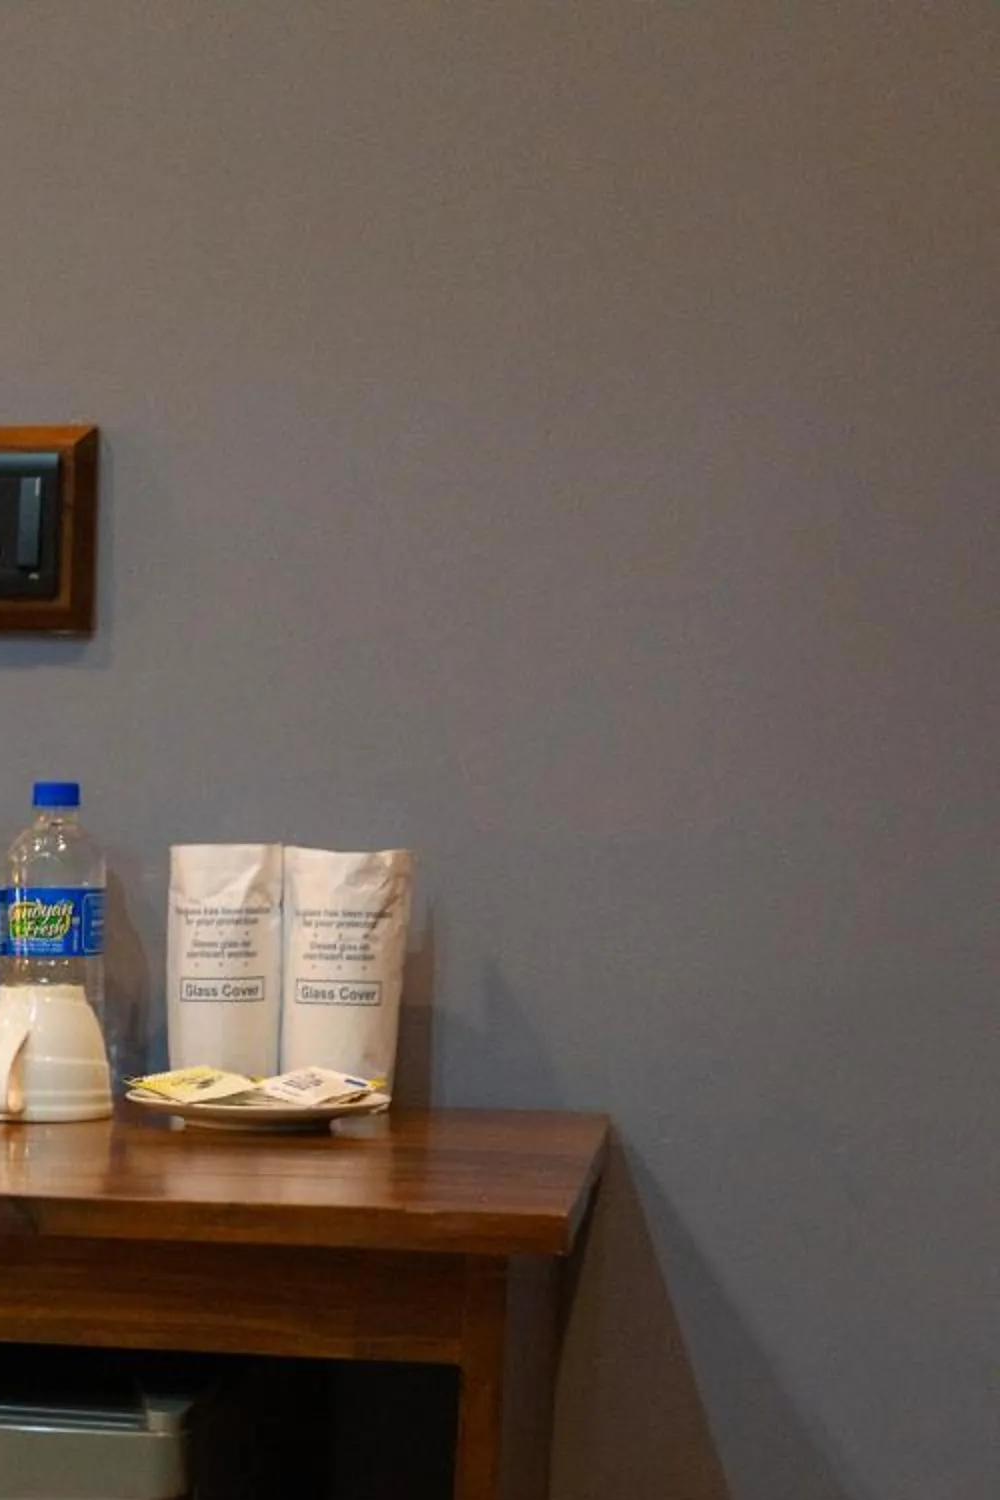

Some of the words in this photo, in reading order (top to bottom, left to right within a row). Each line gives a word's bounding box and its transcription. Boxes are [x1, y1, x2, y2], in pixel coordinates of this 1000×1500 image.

[26, 918, 65, 937] Fresh
[185, 984, 218, 997] Glass
[222, 984, 259, 997] Cover
[301, 986, 335, 1000] Glass
[340, 987, 377, 1001] Cover
